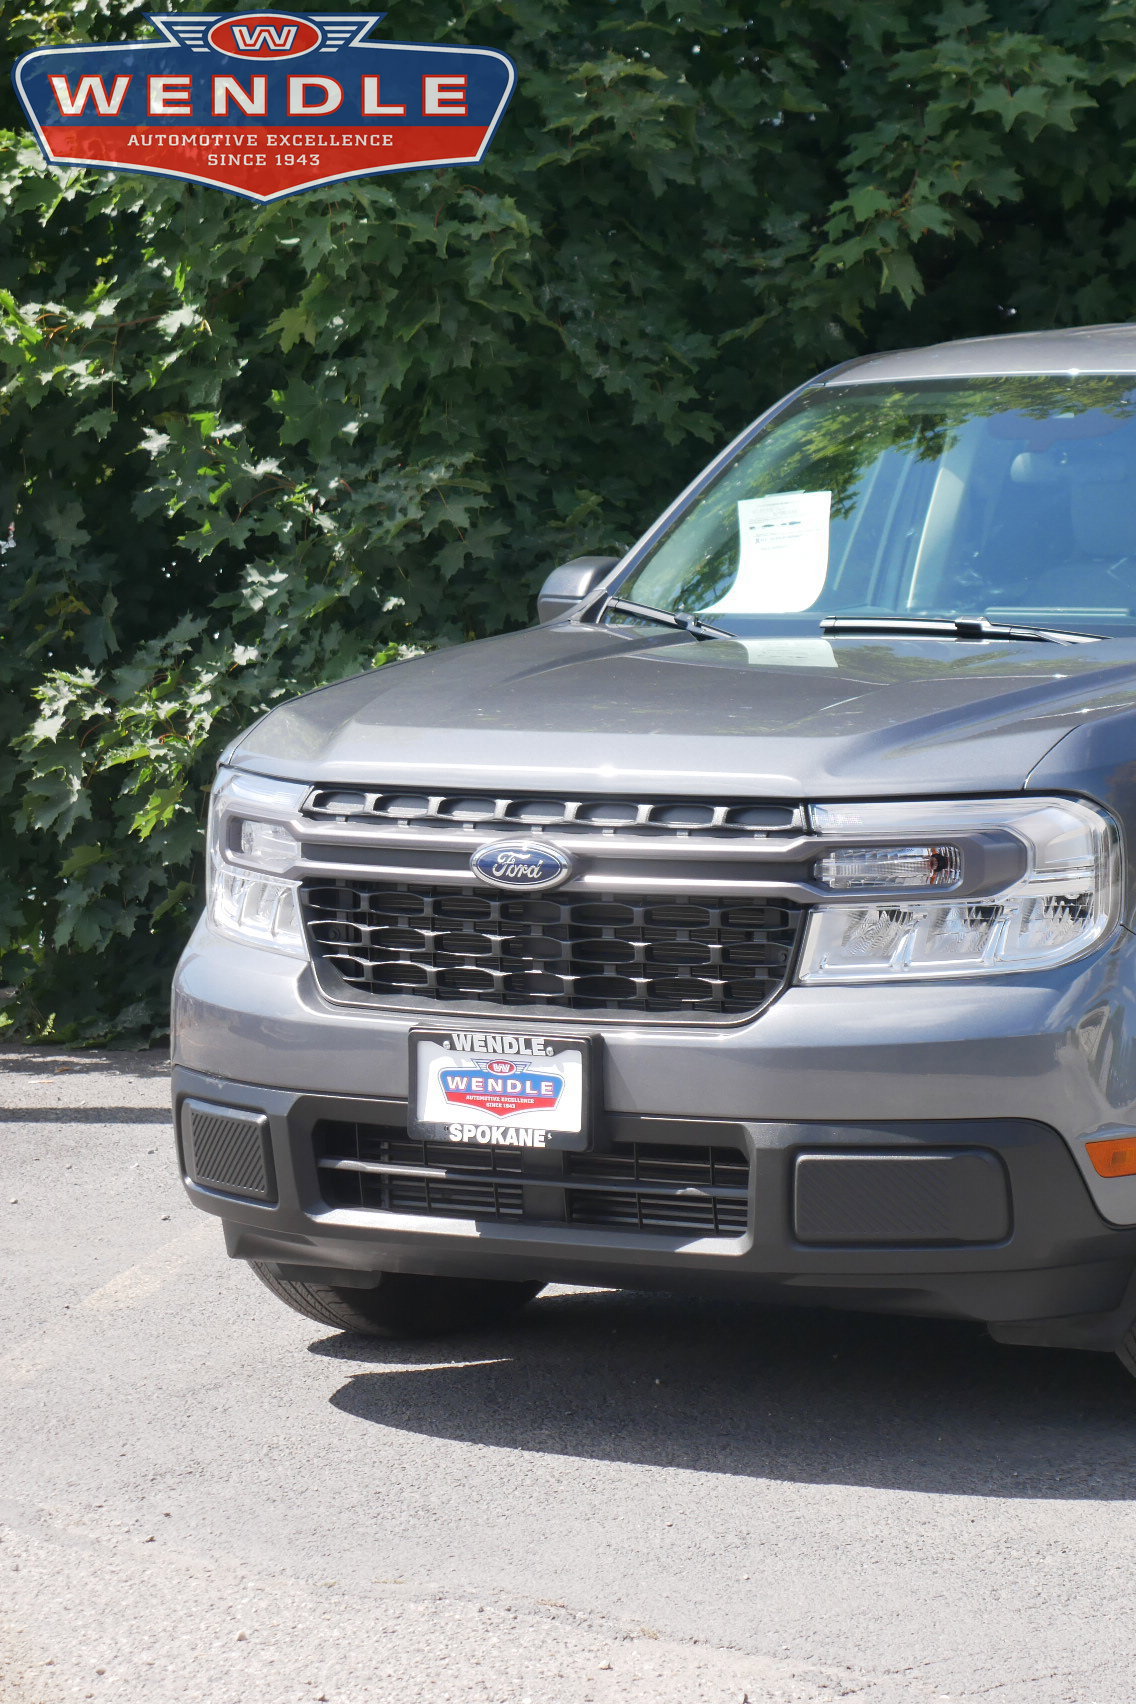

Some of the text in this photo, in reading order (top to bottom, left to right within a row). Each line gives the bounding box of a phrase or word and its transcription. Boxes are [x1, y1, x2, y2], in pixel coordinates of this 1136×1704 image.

[492, 851, 544, 879] Ford
[452, 1033, 547, 1057] WENDLE
[446, 1076, 554, 1096] WENDLE
[449, 1123, 546, 1148] SPOKANE
